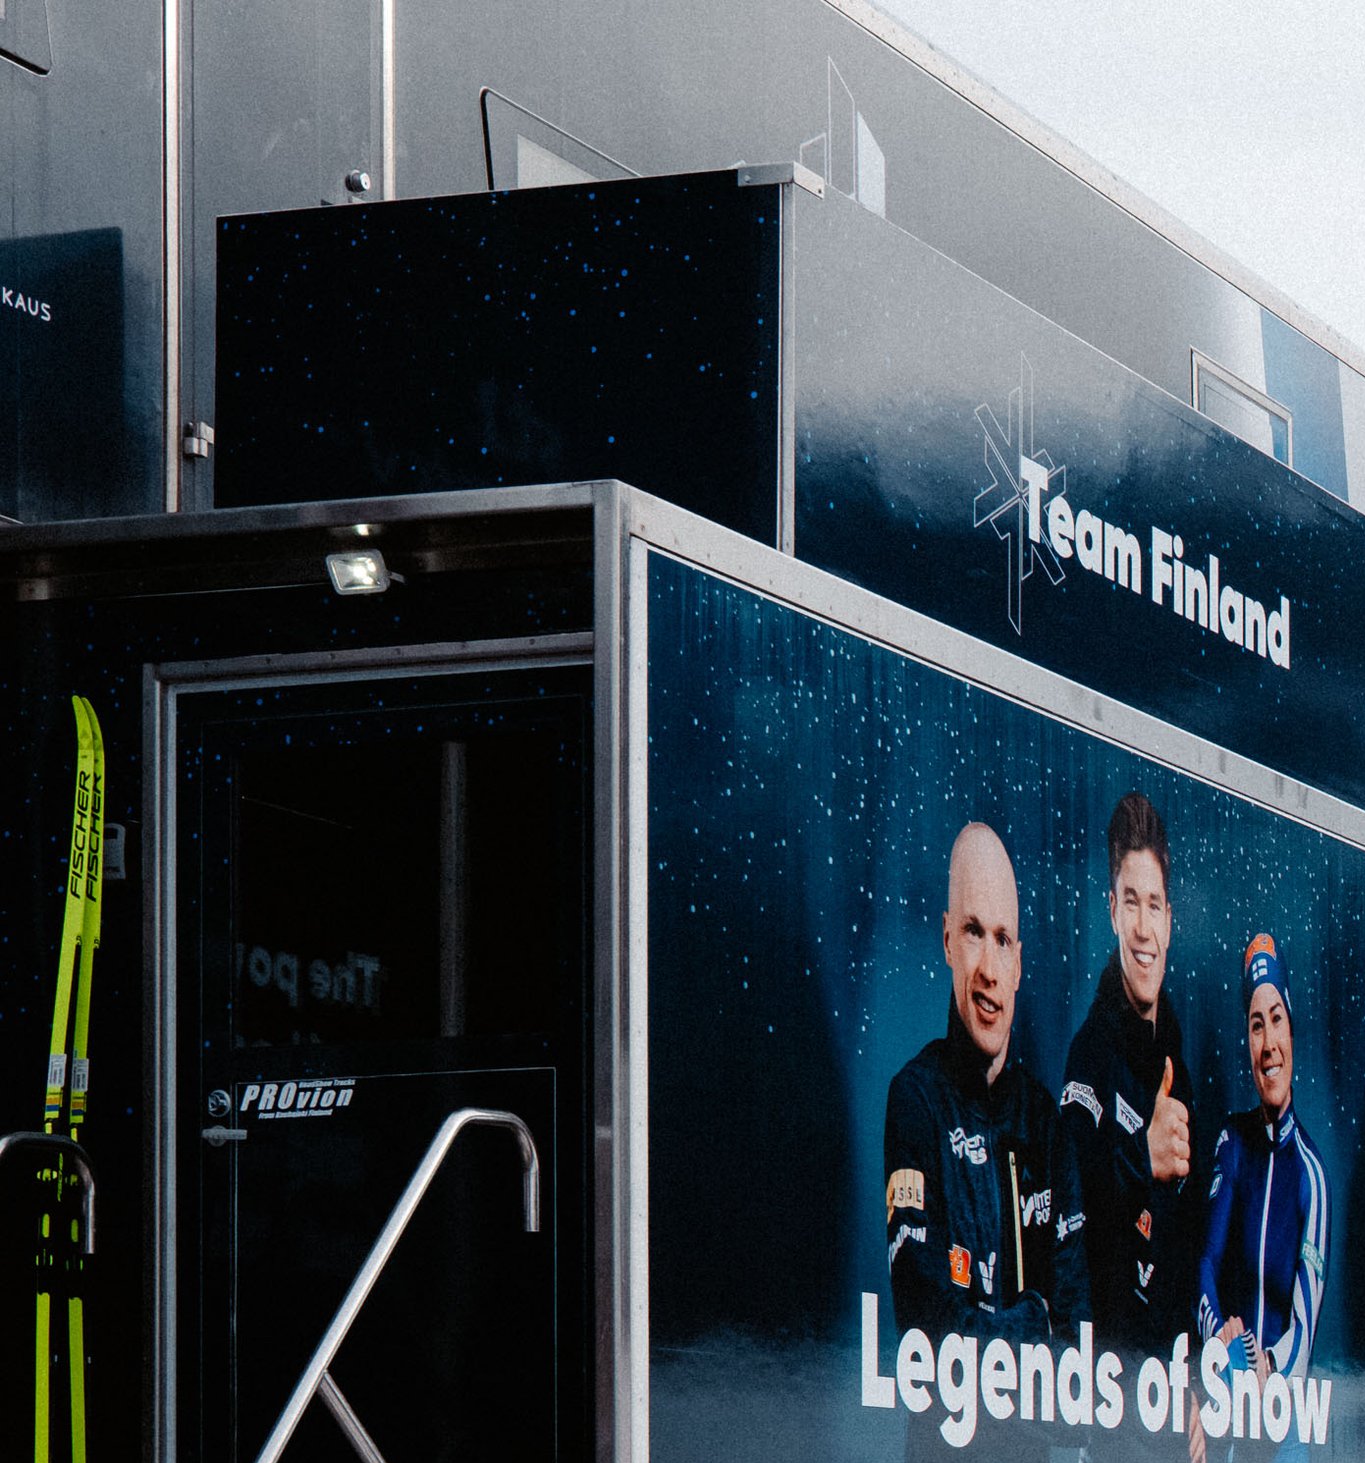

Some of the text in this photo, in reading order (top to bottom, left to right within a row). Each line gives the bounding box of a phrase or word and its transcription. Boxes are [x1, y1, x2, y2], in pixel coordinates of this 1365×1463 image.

[1021, 455, 1290, 671] Team Finland
[70, 770, 91, 899] FISCHER
[240, 1082, 354, 1111] PROvion
[861, 1292, 1332, 1448] Legends of Snow
